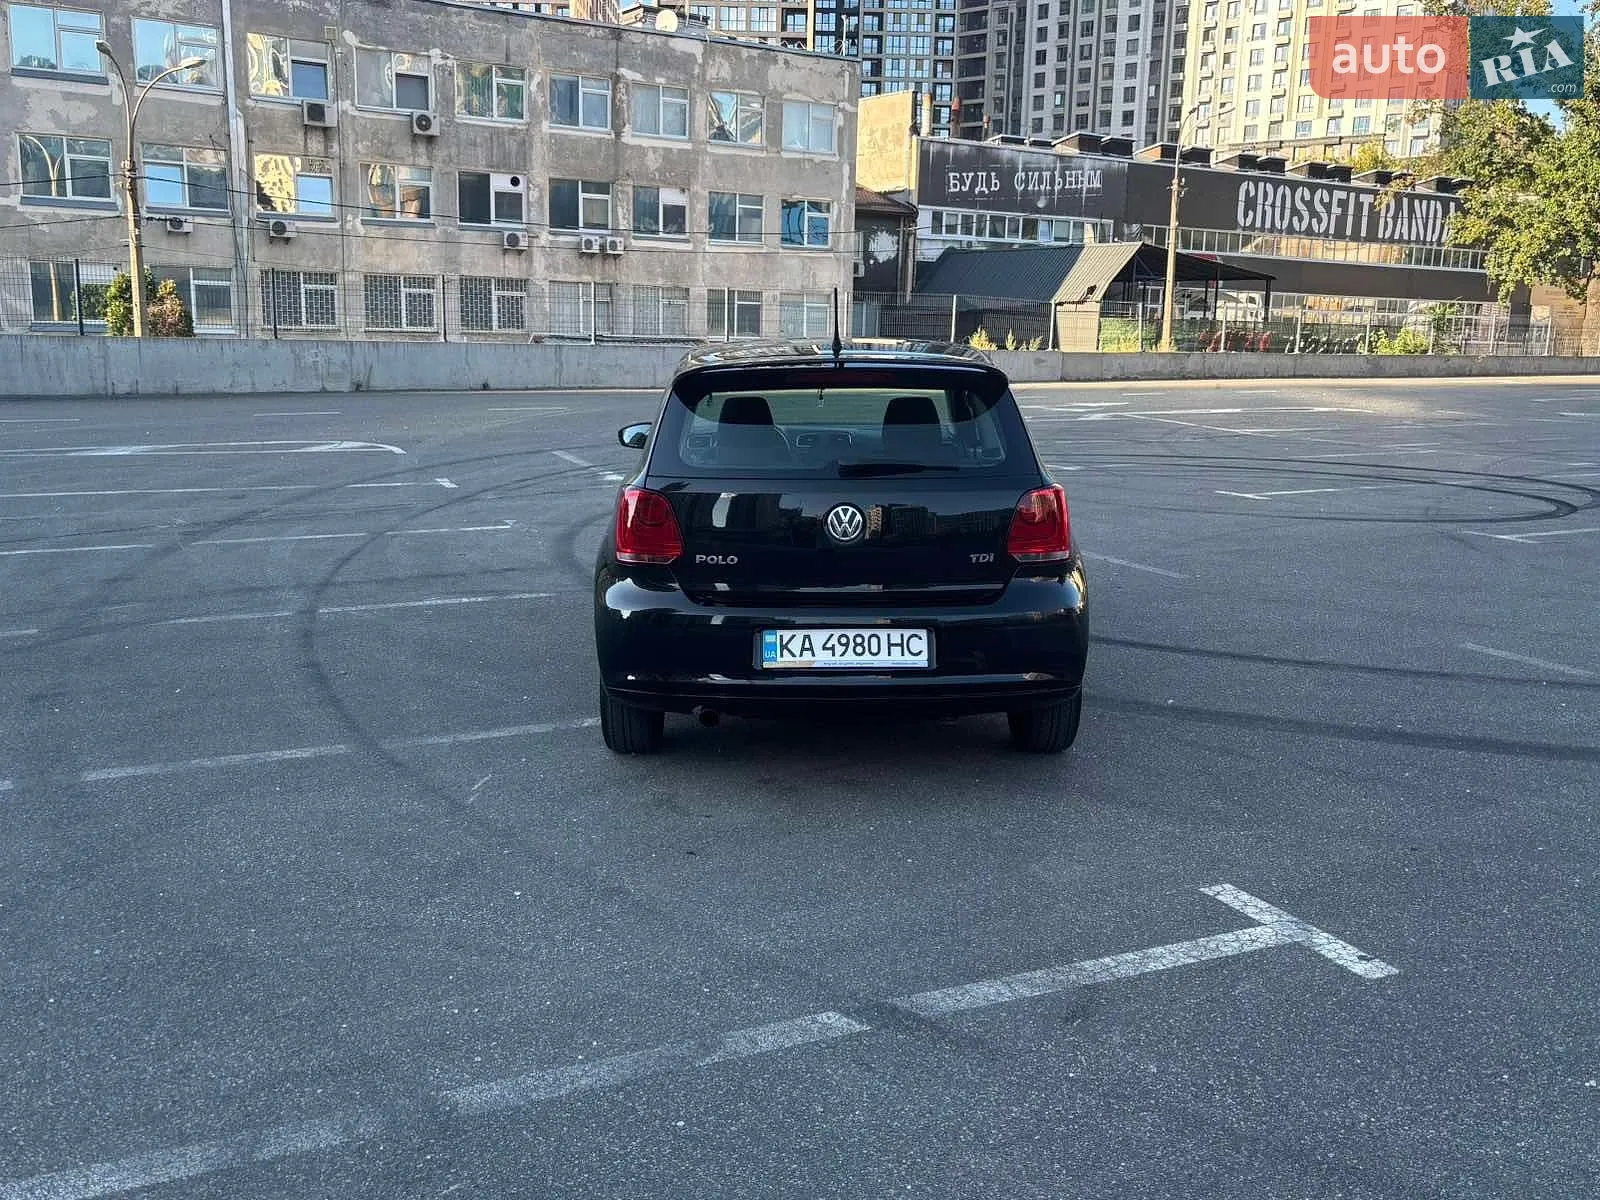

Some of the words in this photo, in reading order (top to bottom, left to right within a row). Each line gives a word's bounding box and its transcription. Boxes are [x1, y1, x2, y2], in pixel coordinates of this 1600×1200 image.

[948, 172, 1000, 195] БУДЬ
[1237, 180, 1374, 237] CROSSFIT
[695, 554, 738, 565] POLO
[764, 650, 777, 659] UA
[779, 634, 816, 658] KA
[821, 633, 881, 657] 4980
[887, 633, 924, 657] HC
